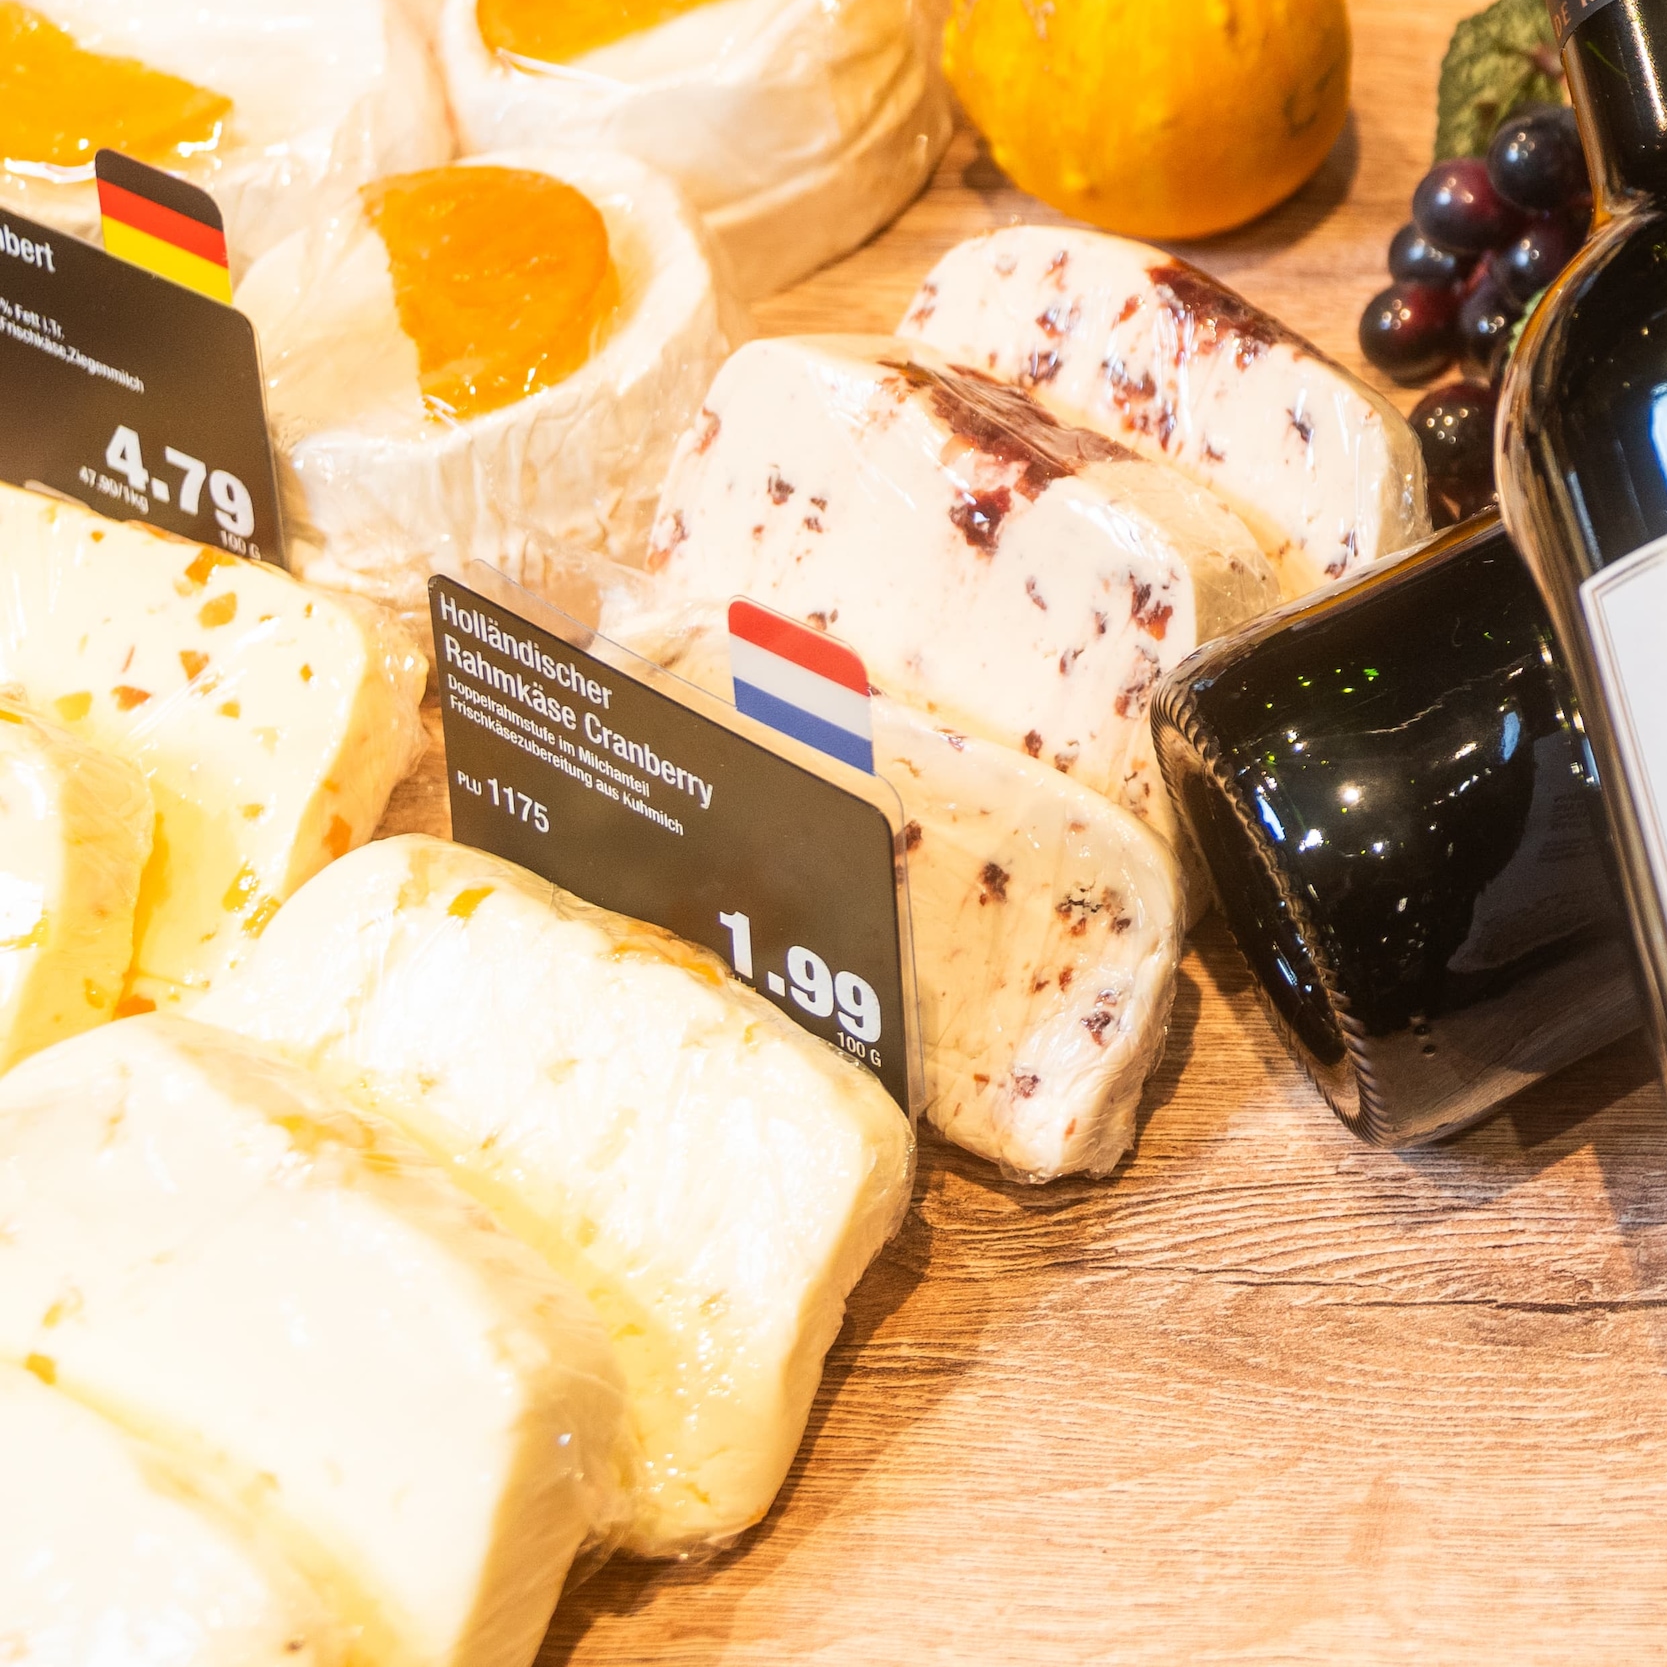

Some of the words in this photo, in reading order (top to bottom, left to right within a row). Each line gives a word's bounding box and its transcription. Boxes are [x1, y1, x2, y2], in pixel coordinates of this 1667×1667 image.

[1555, 6, 1573, 38] DE
[15, 304, 40, 328] Fett
[106, 424, 255, 538] 4.79
[220, 530, 247, 557] 100
[441, 595, 611, 707] Holländischer
[445, 635, 575, 729] Rahmkäse
[585, 714, 712, 806] Cranberry
[448, 674, 555, 744] Doppelrahmstufe
[559, 735, 575, 757] im
[579, 747, 649, 796] Milchanteil
[451, 696, 592, 787] Frischkäsezubereitung
[596, 779, 619, 800] aus
[623, 792, 683, 835] Kuhmilch
[458, 771, 482, 795] PLU
[488, 779, 549, 832] 1175
[720, 911, 882, 1042] 1.99
[836, 1030, 866, 1059] 100
[869, 1046, 883, 1068] G
